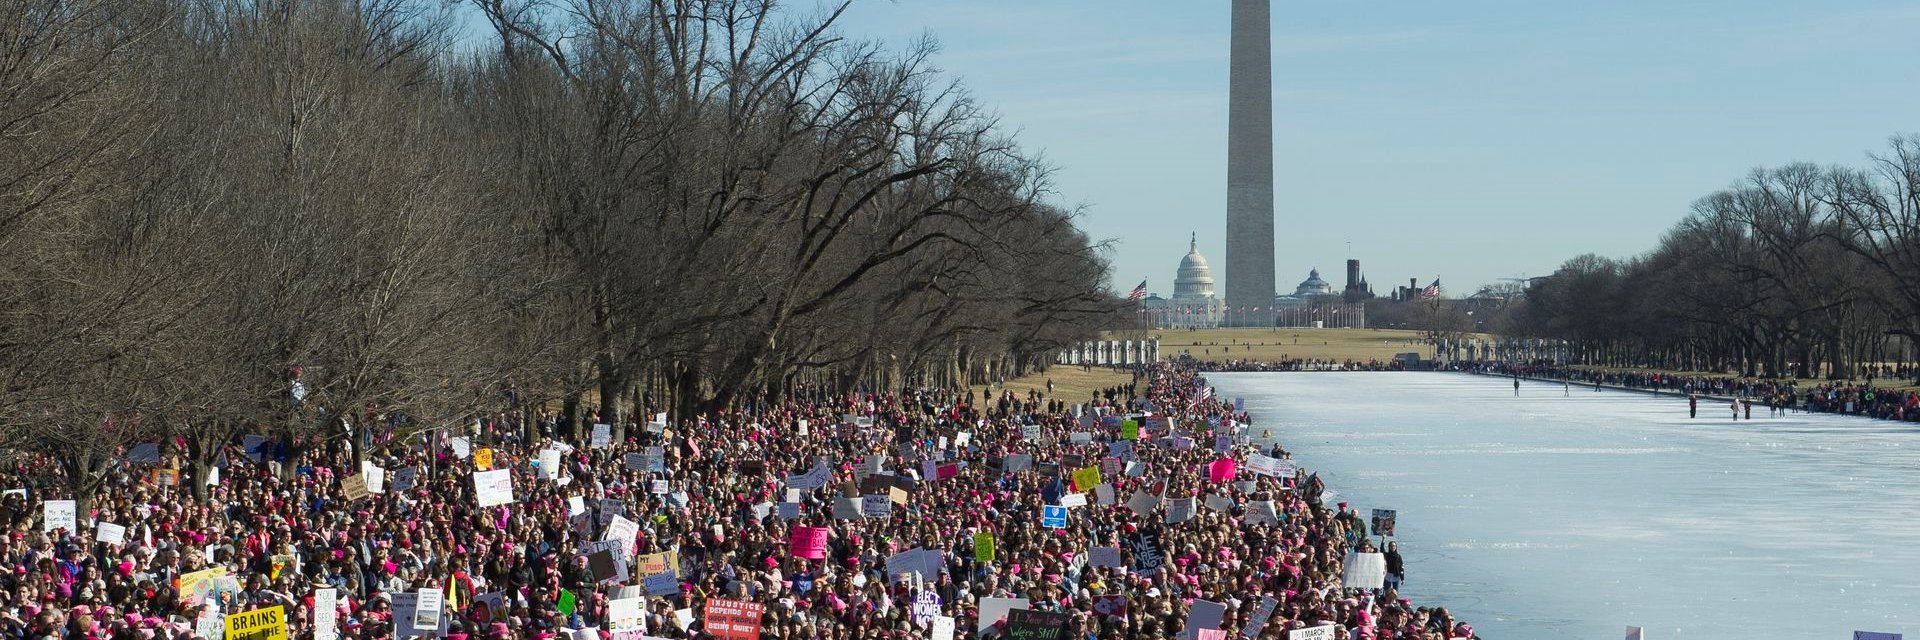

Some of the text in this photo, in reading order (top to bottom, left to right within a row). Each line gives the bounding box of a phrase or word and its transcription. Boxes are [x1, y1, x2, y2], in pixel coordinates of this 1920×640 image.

[1130, 533, 1156, 552] WE
[1135, 549, 1159, 563] ARE
[917, 590, 941, 605] ELECT
[711, 599, 760, 610] INJUSTICE
[709, 606, 757, 618] DEPENDS ON
[232, 610, 277, 631] BRAINS
[731, 617, 758, 625] PEOPLE
[260, 625, 280, 638] THE
[708, 622, 754, 633] BEING QUIET
[1039, 627, 1060, 639] Still
[1305, 627, 1325, 637] MARCH
